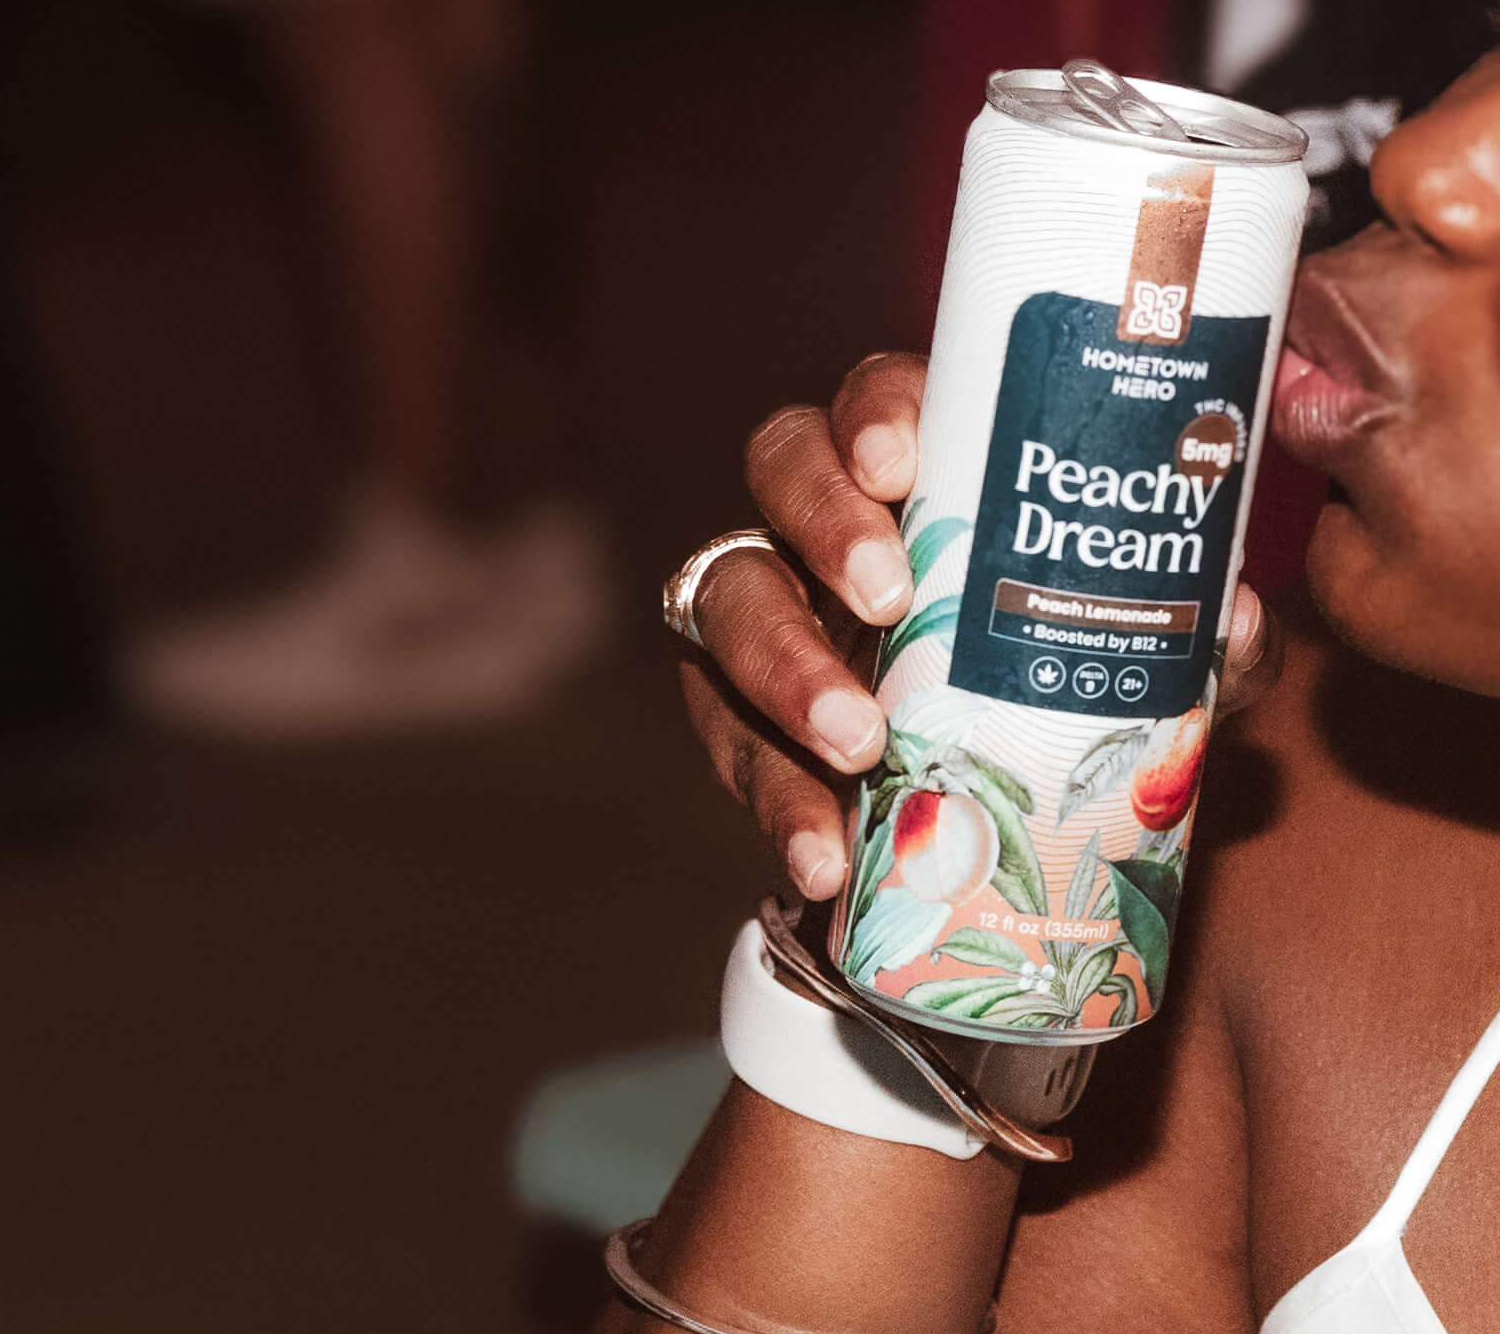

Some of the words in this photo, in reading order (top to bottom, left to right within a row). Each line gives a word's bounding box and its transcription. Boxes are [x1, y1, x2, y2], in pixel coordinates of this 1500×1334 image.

[1082, 347, 1209, 381] HOMETOWN
[1111, 375, 1176, 401] HERO
[1181, 437, 1233, 468] 5mg
[1015, 439, 1223, 529] Peachy
[1012, 500, 1203, 573] Dream
[1027, 593, 1084, 618] Peach
[1085, 603, 1173, 625] Lemonade
[1034, 624, 1105, 648] Boosted
[1107, 633, 1130, 653] by
[1131, 636, 1157, 651] B12
[979, 912, 998, 929] 12
[1002, 915, 1014, 932] fl
[1018, 921, 1040, 936] oz
[1044, 920, 1109, 939] (355ml)
